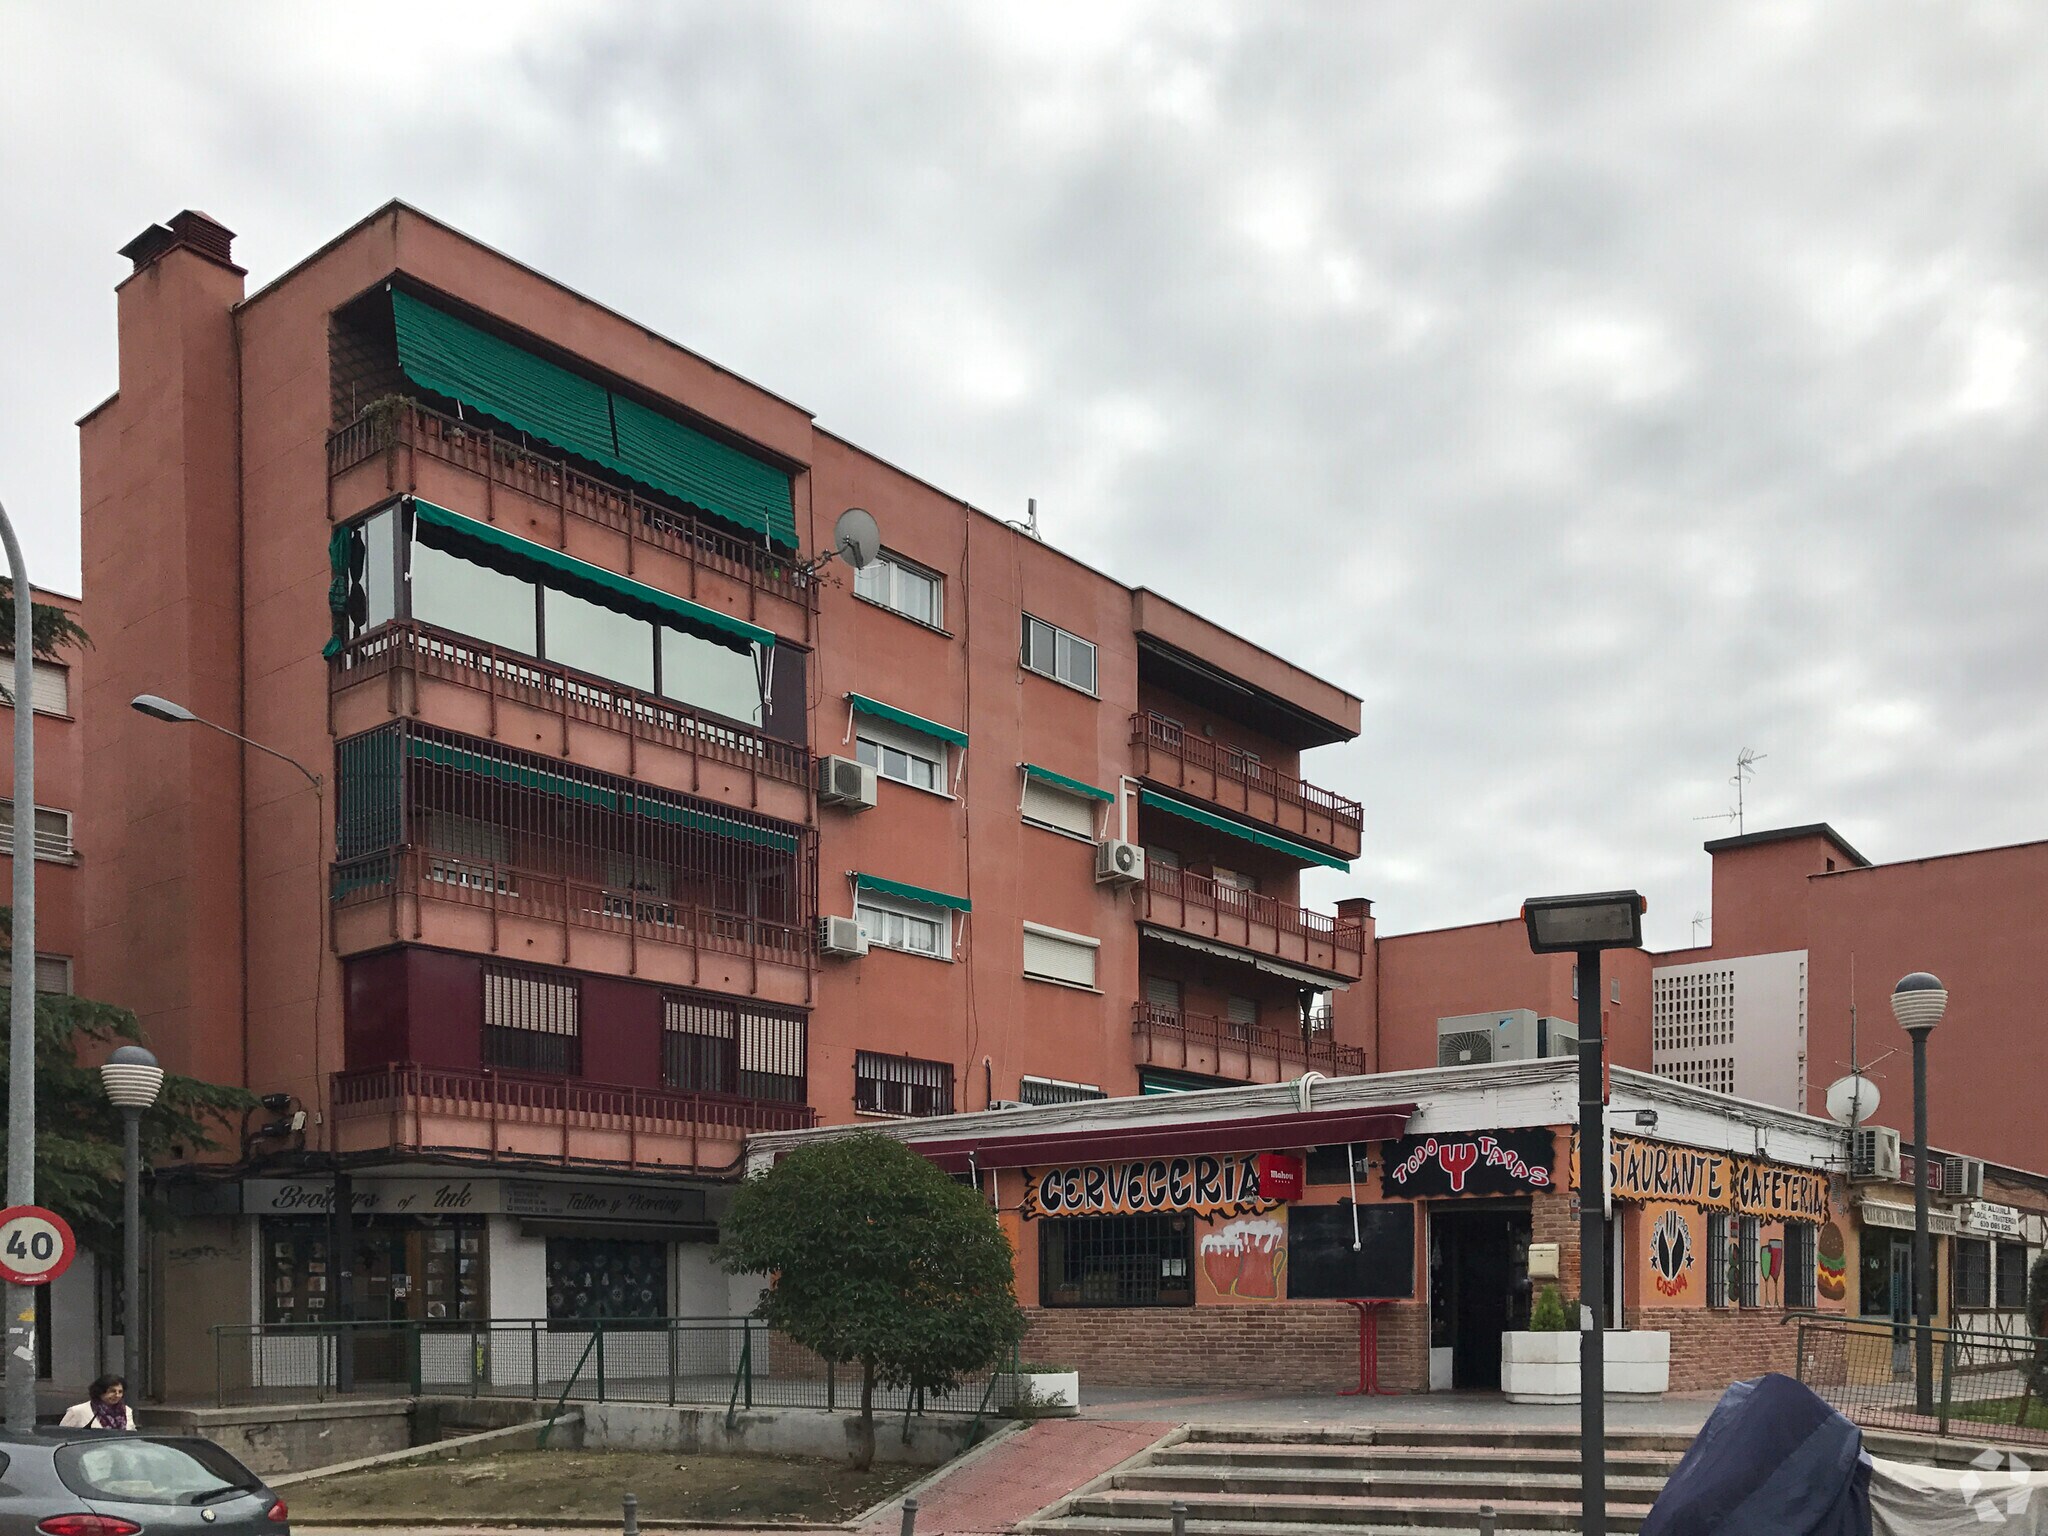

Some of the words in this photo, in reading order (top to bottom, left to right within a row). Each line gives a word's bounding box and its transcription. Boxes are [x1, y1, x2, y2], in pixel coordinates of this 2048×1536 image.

[1393, 1138, 1438, 1184] TODO
[1478, 1136, 1549, 1186] TAPAS
[1270, 1169, 1294, 1181] Mahou
[432, 1182, 472, 1209] Ink
[566, 1191, 608, 1211] Tattoo
[608, 1198, 622, 1214] y
[627, 1192, 684, 1215] Piercing
[7, 1230, 54, 1260] 40
